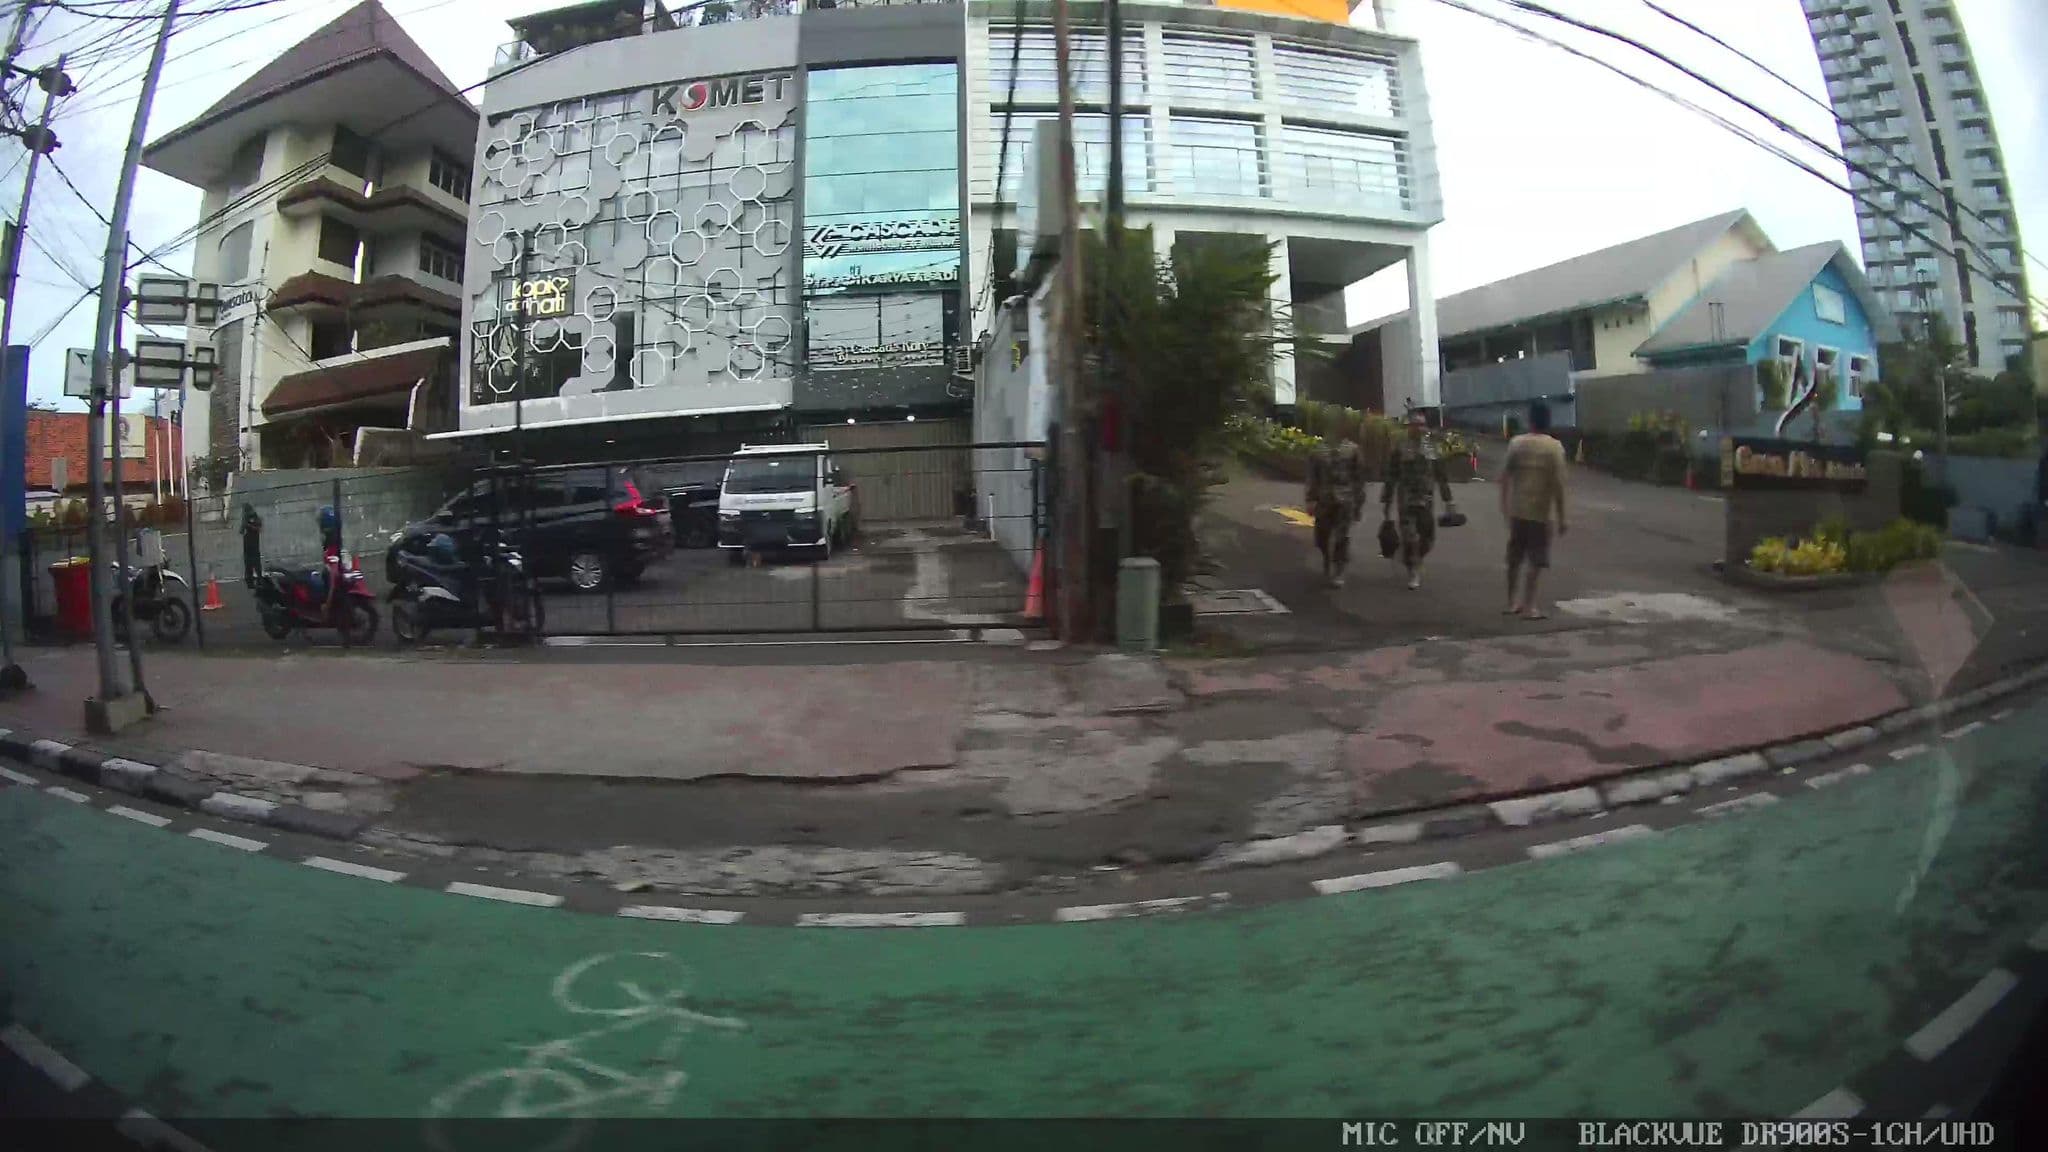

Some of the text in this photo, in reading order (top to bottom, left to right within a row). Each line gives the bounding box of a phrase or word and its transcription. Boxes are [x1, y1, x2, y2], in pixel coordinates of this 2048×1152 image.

[651, 72, 793, 116] KOMET
[511, 275, 554, 300] kopi
[529, 292, 567, 317] hati
